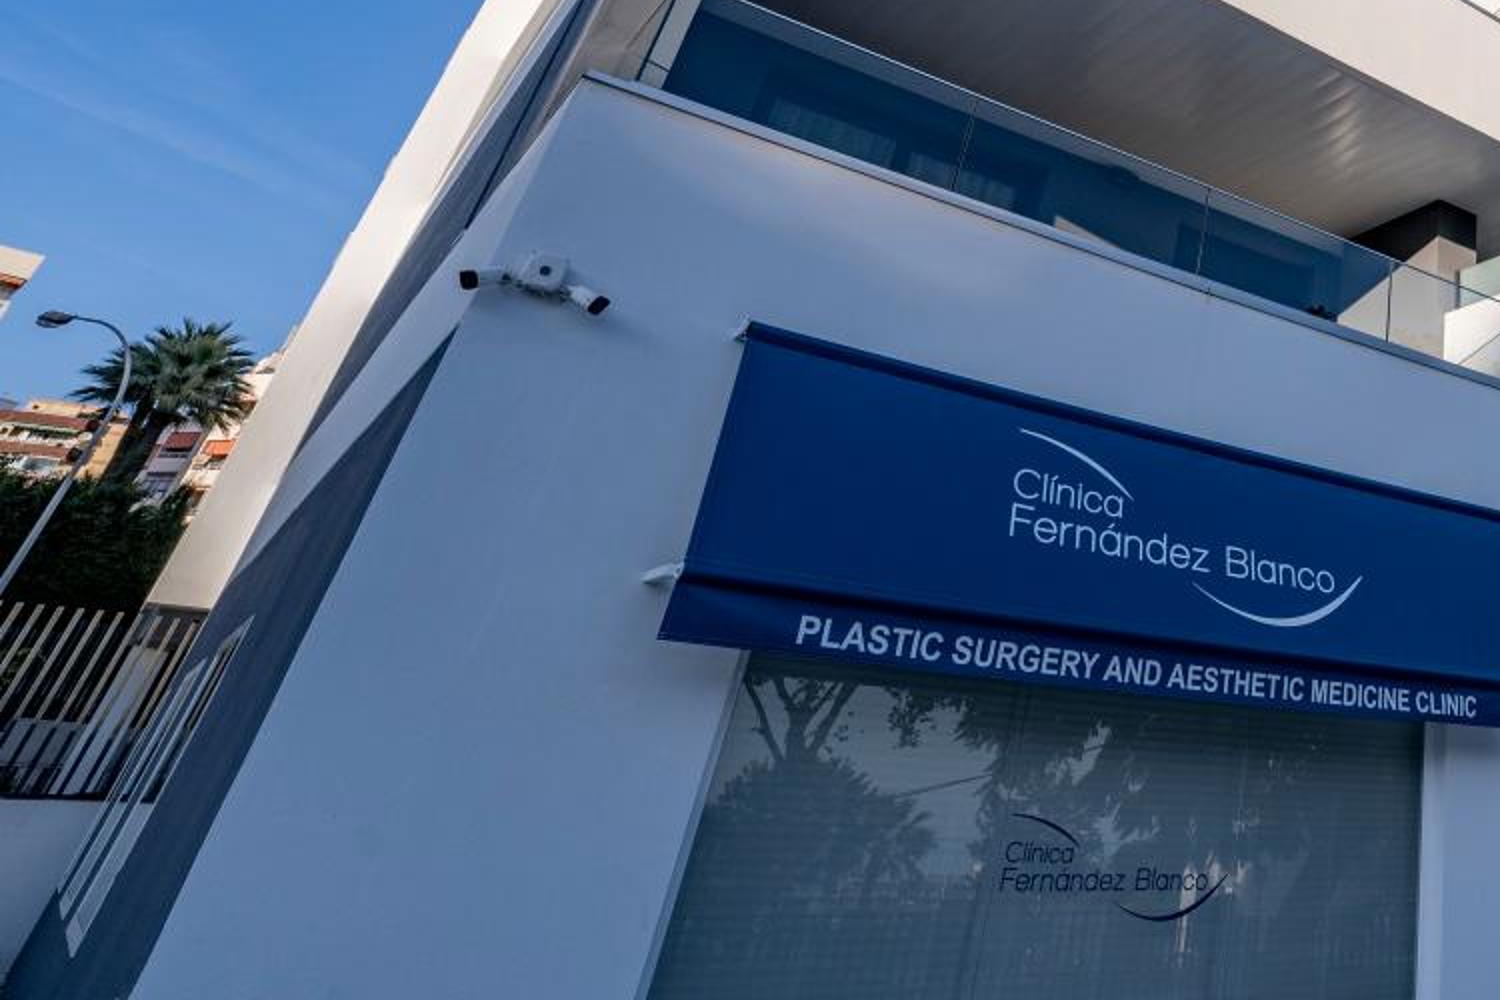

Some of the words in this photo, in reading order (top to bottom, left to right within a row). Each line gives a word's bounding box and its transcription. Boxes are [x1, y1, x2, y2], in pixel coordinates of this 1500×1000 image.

[1013, 467, 1124, 518] Clínica
[1009, 502, 1211, 574] Fernández
[1225, 545, 1336, 593] Blanco
[796, 614, 943, 662] PLASTIC
[952, 635, 1101, 680] SURGERY
[1102, 653, 1162, 687] AND
[1167, 662, 1305, 702] AESTHETIC
[1310, 678, 1412, 713] MEDICINE
[1415, 689, 1478, 719] CLINIC
[1005, 841, 1075, 864] Clínica
[1000, 866, 1126, 893] Fernández
[1135, 866, 1209, 892] Blanco
